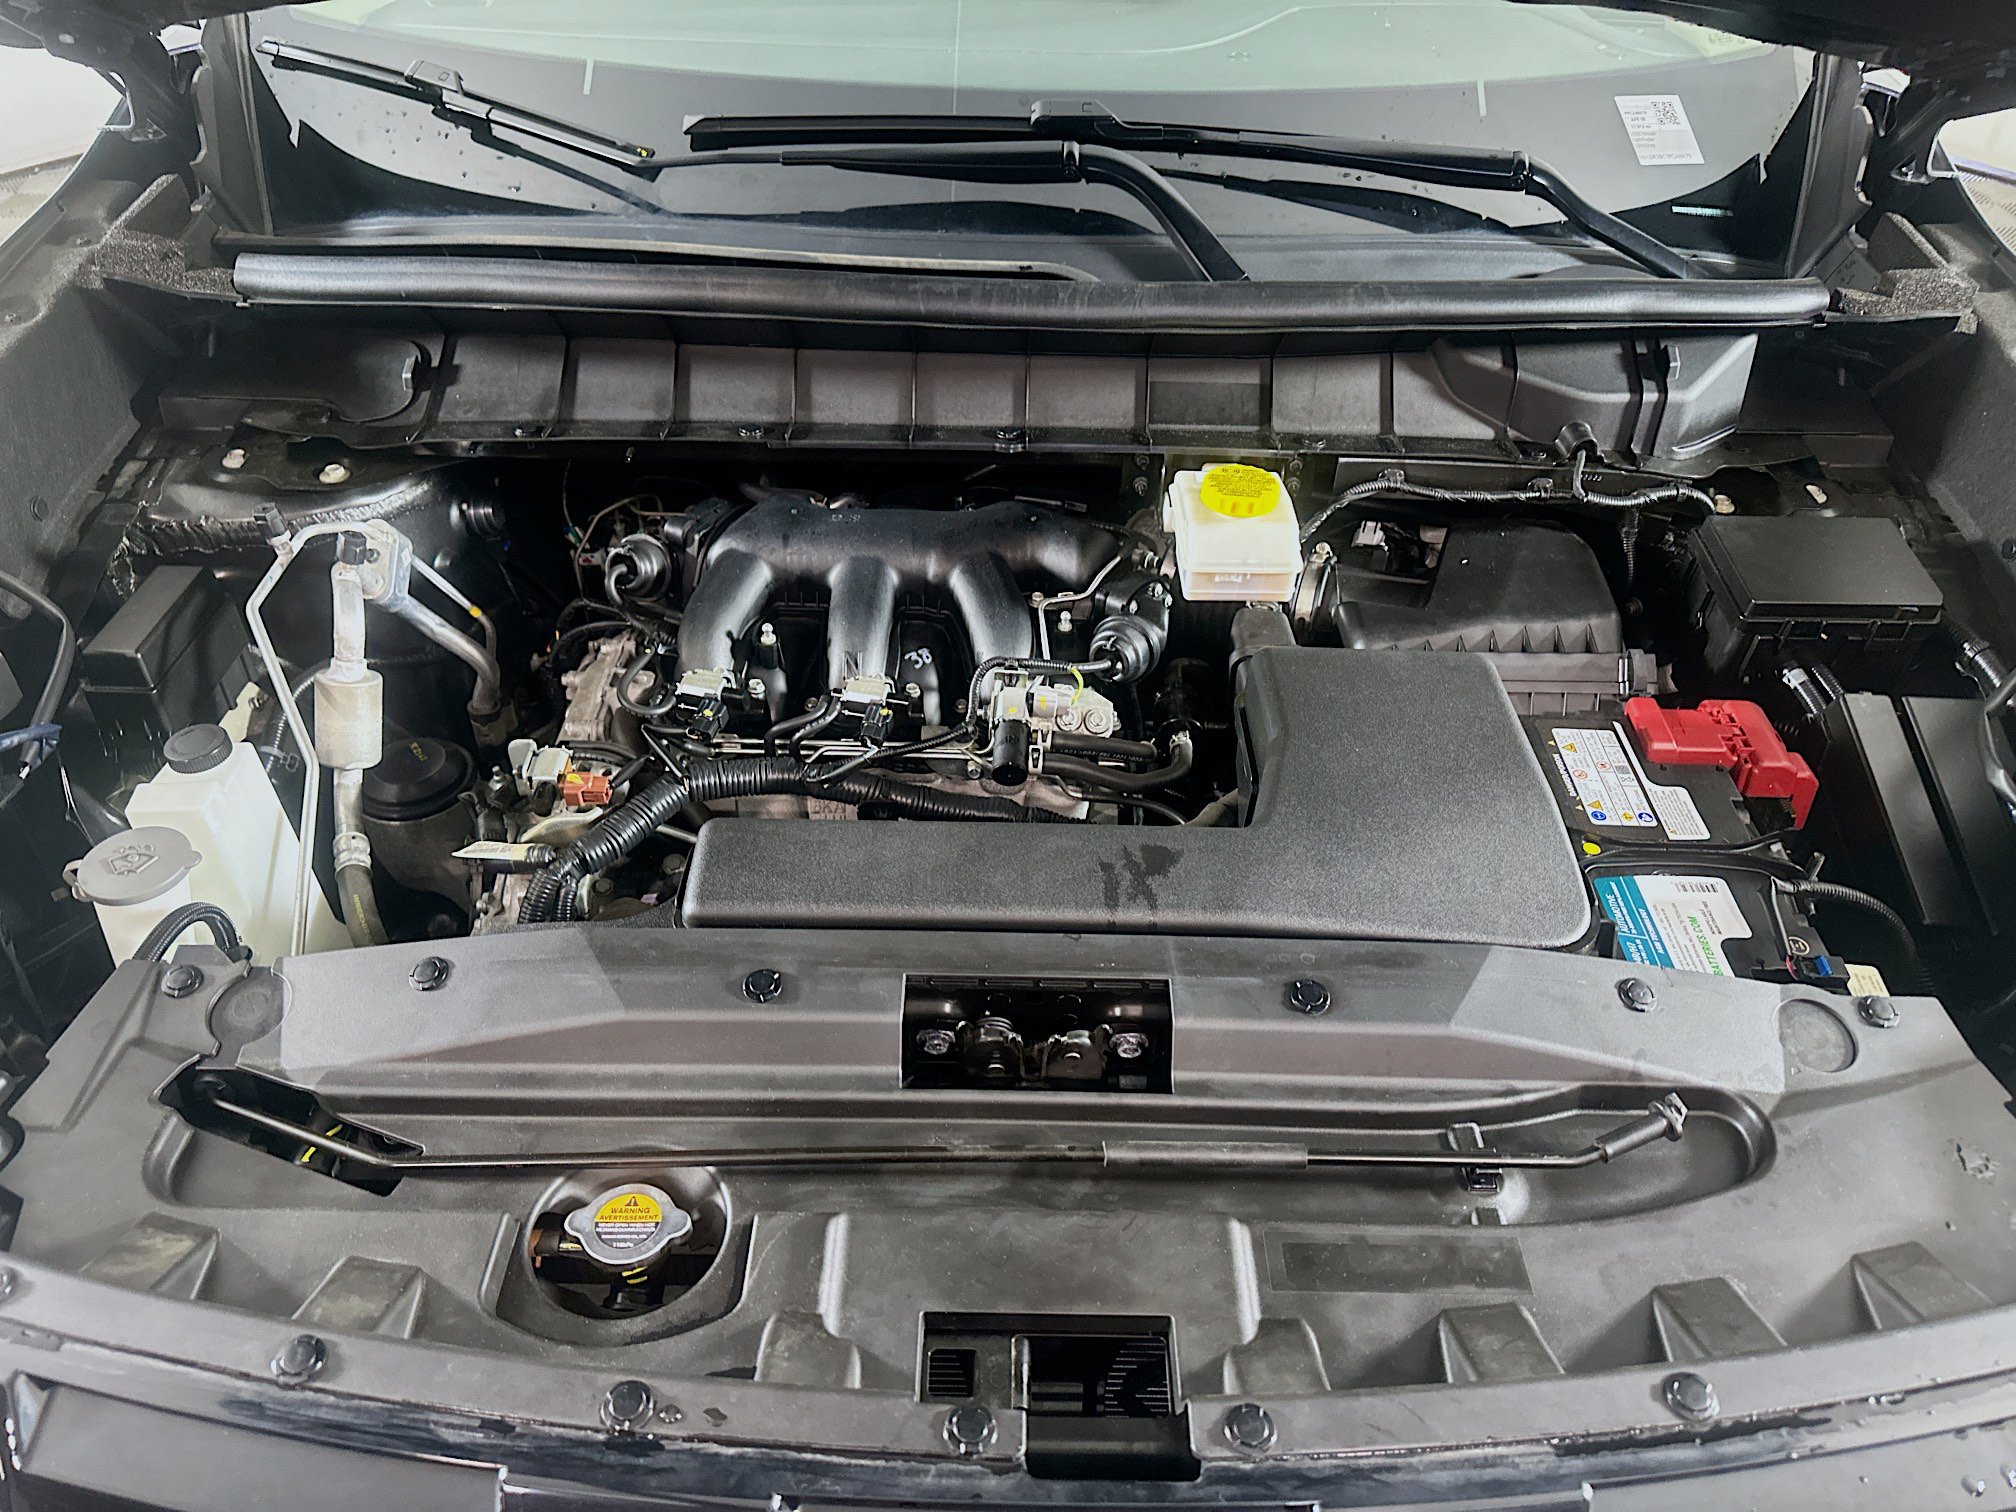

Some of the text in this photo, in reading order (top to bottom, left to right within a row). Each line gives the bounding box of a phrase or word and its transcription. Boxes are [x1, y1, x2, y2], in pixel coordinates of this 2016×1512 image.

[904, 647, 932, 670] 38
[1605, 893, 1630, 934] AUTOMOTIVE
[1638, 908, 1658, 942] TECHNOLOGY
